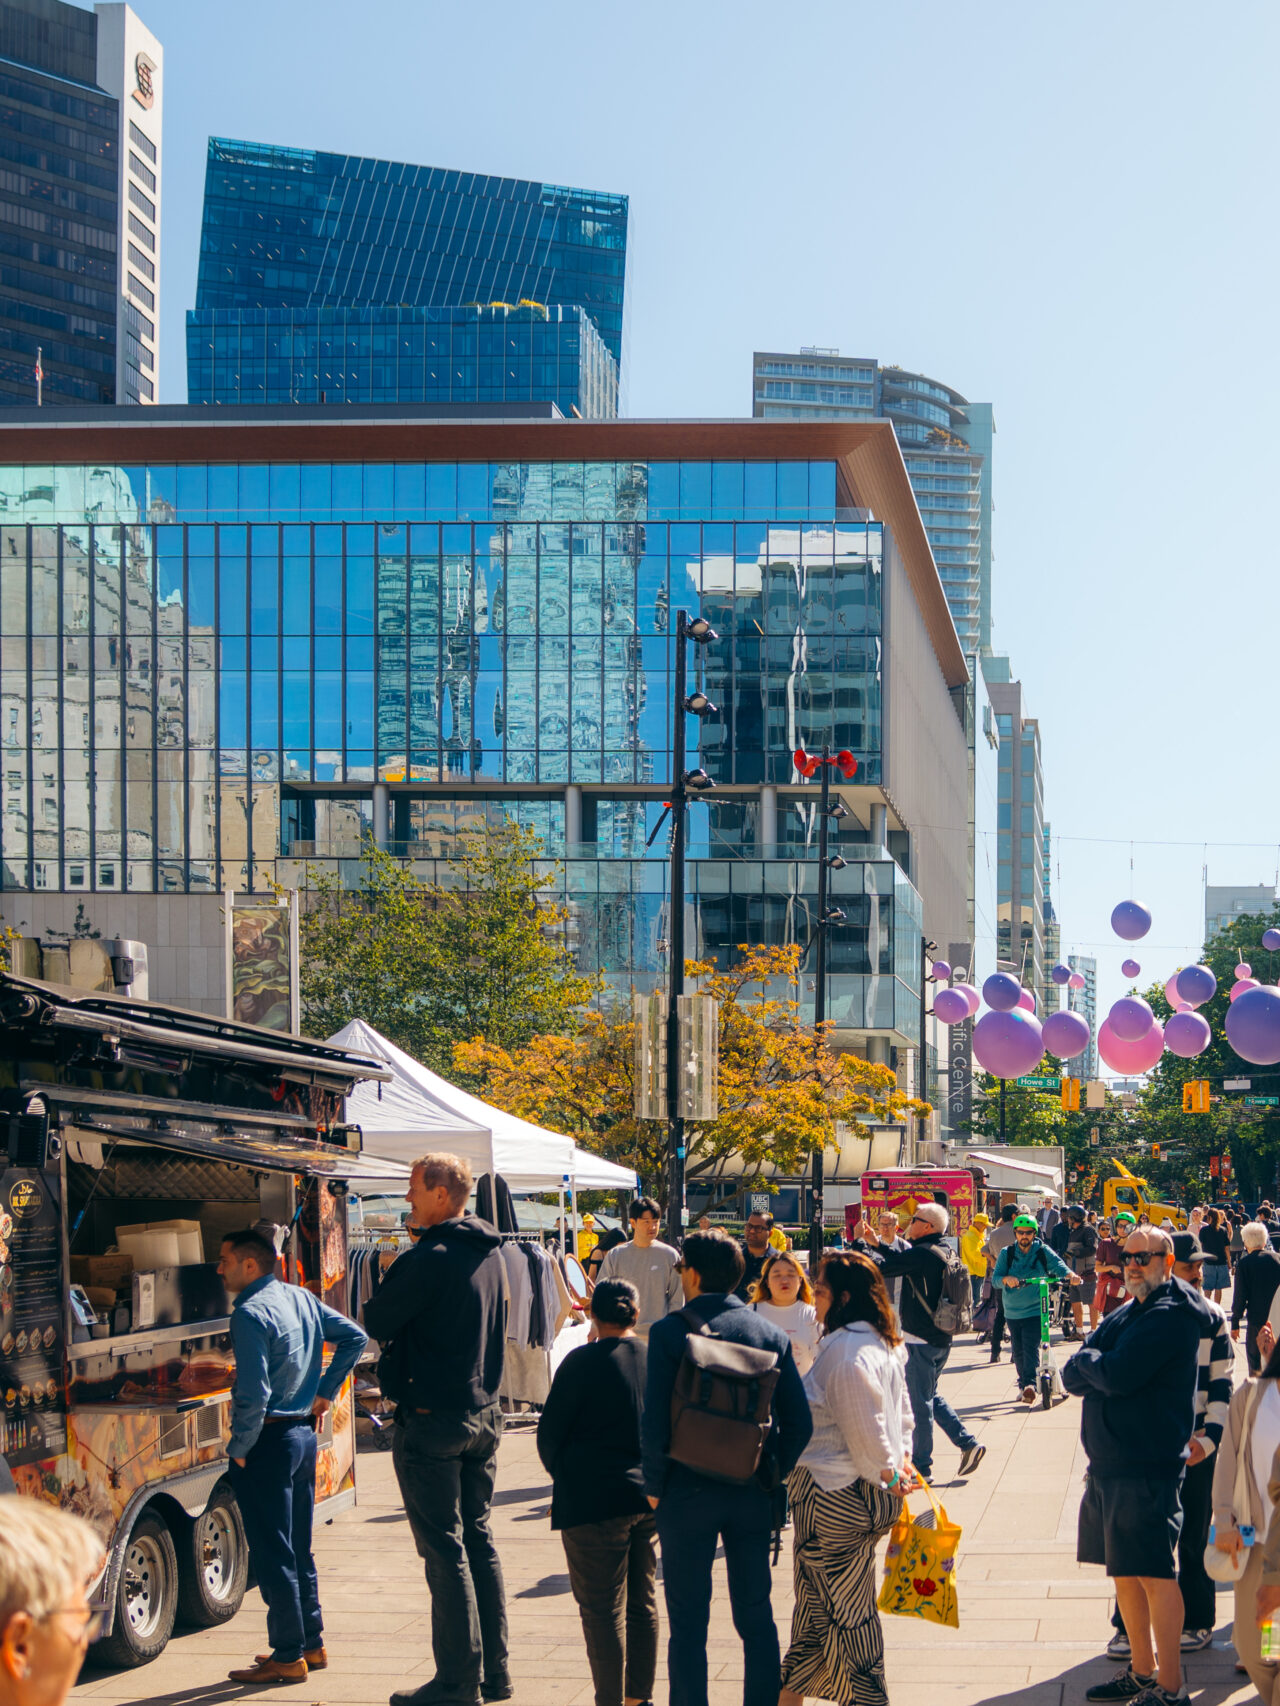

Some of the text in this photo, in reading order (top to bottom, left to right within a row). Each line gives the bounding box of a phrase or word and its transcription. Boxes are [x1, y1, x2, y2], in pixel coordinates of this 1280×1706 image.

[952, 1056, 967, 1113] Centre
[1020, 1078, 1056, 1087] Howe St
